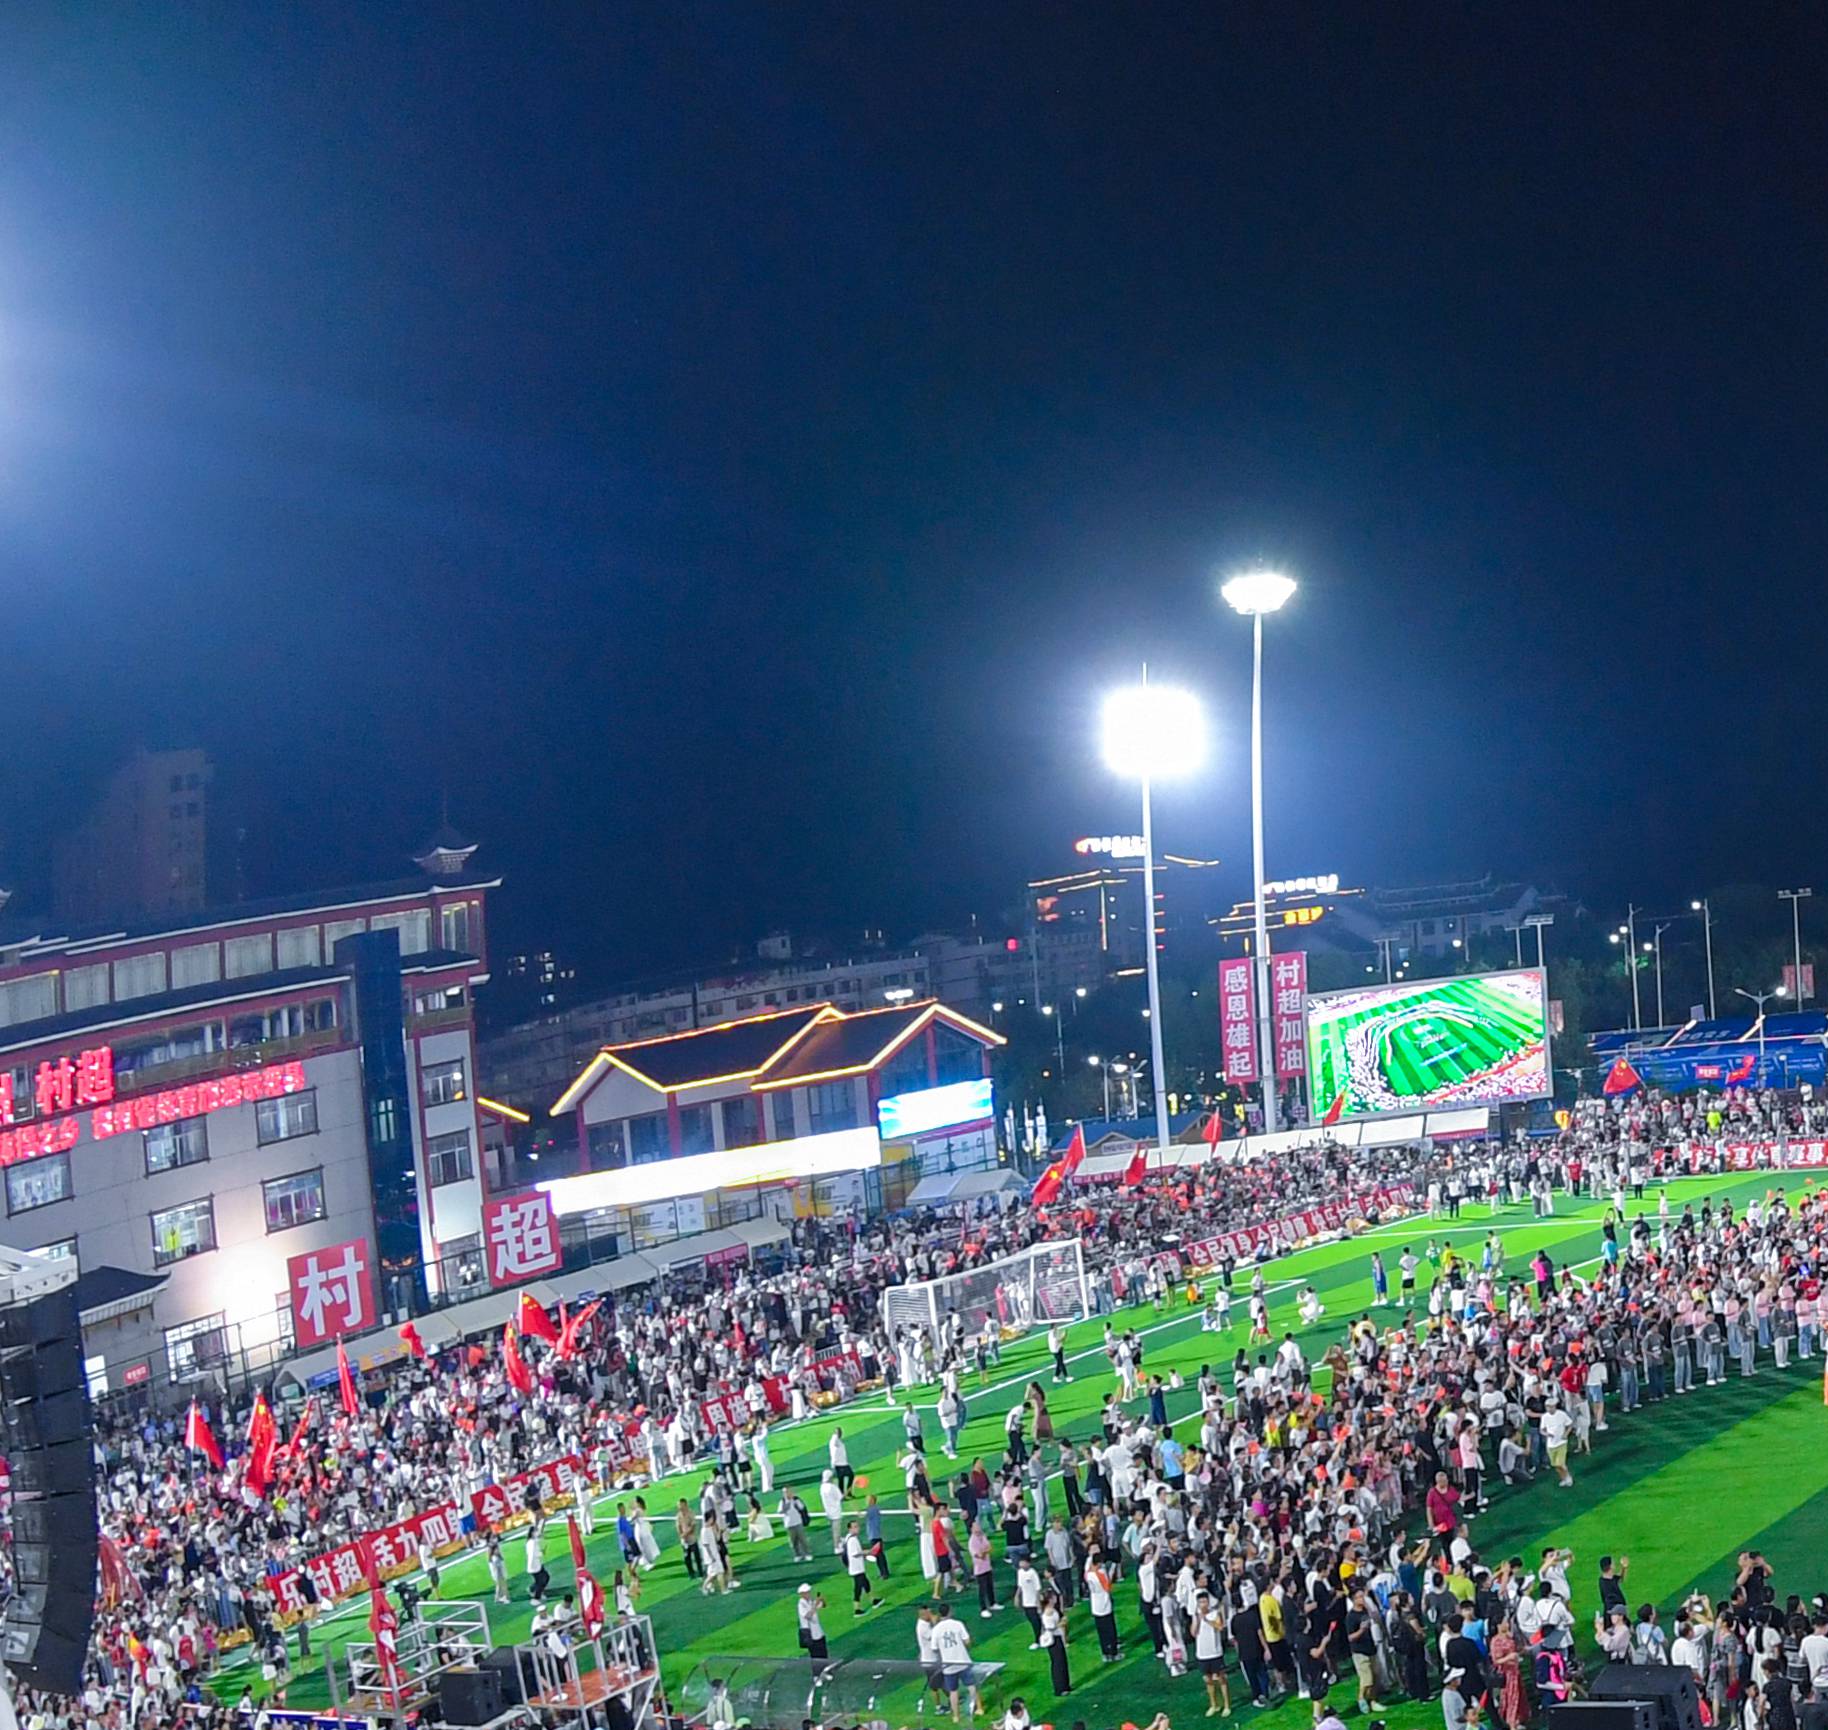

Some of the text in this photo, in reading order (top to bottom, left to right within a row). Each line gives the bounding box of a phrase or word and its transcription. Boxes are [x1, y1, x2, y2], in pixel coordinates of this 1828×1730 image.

[1224, 966, 1252, 1077] 感恩雄起
[1276, 960, 1304, 1071] 村超加油
[298, 1199, 556, 1337] 村 超
